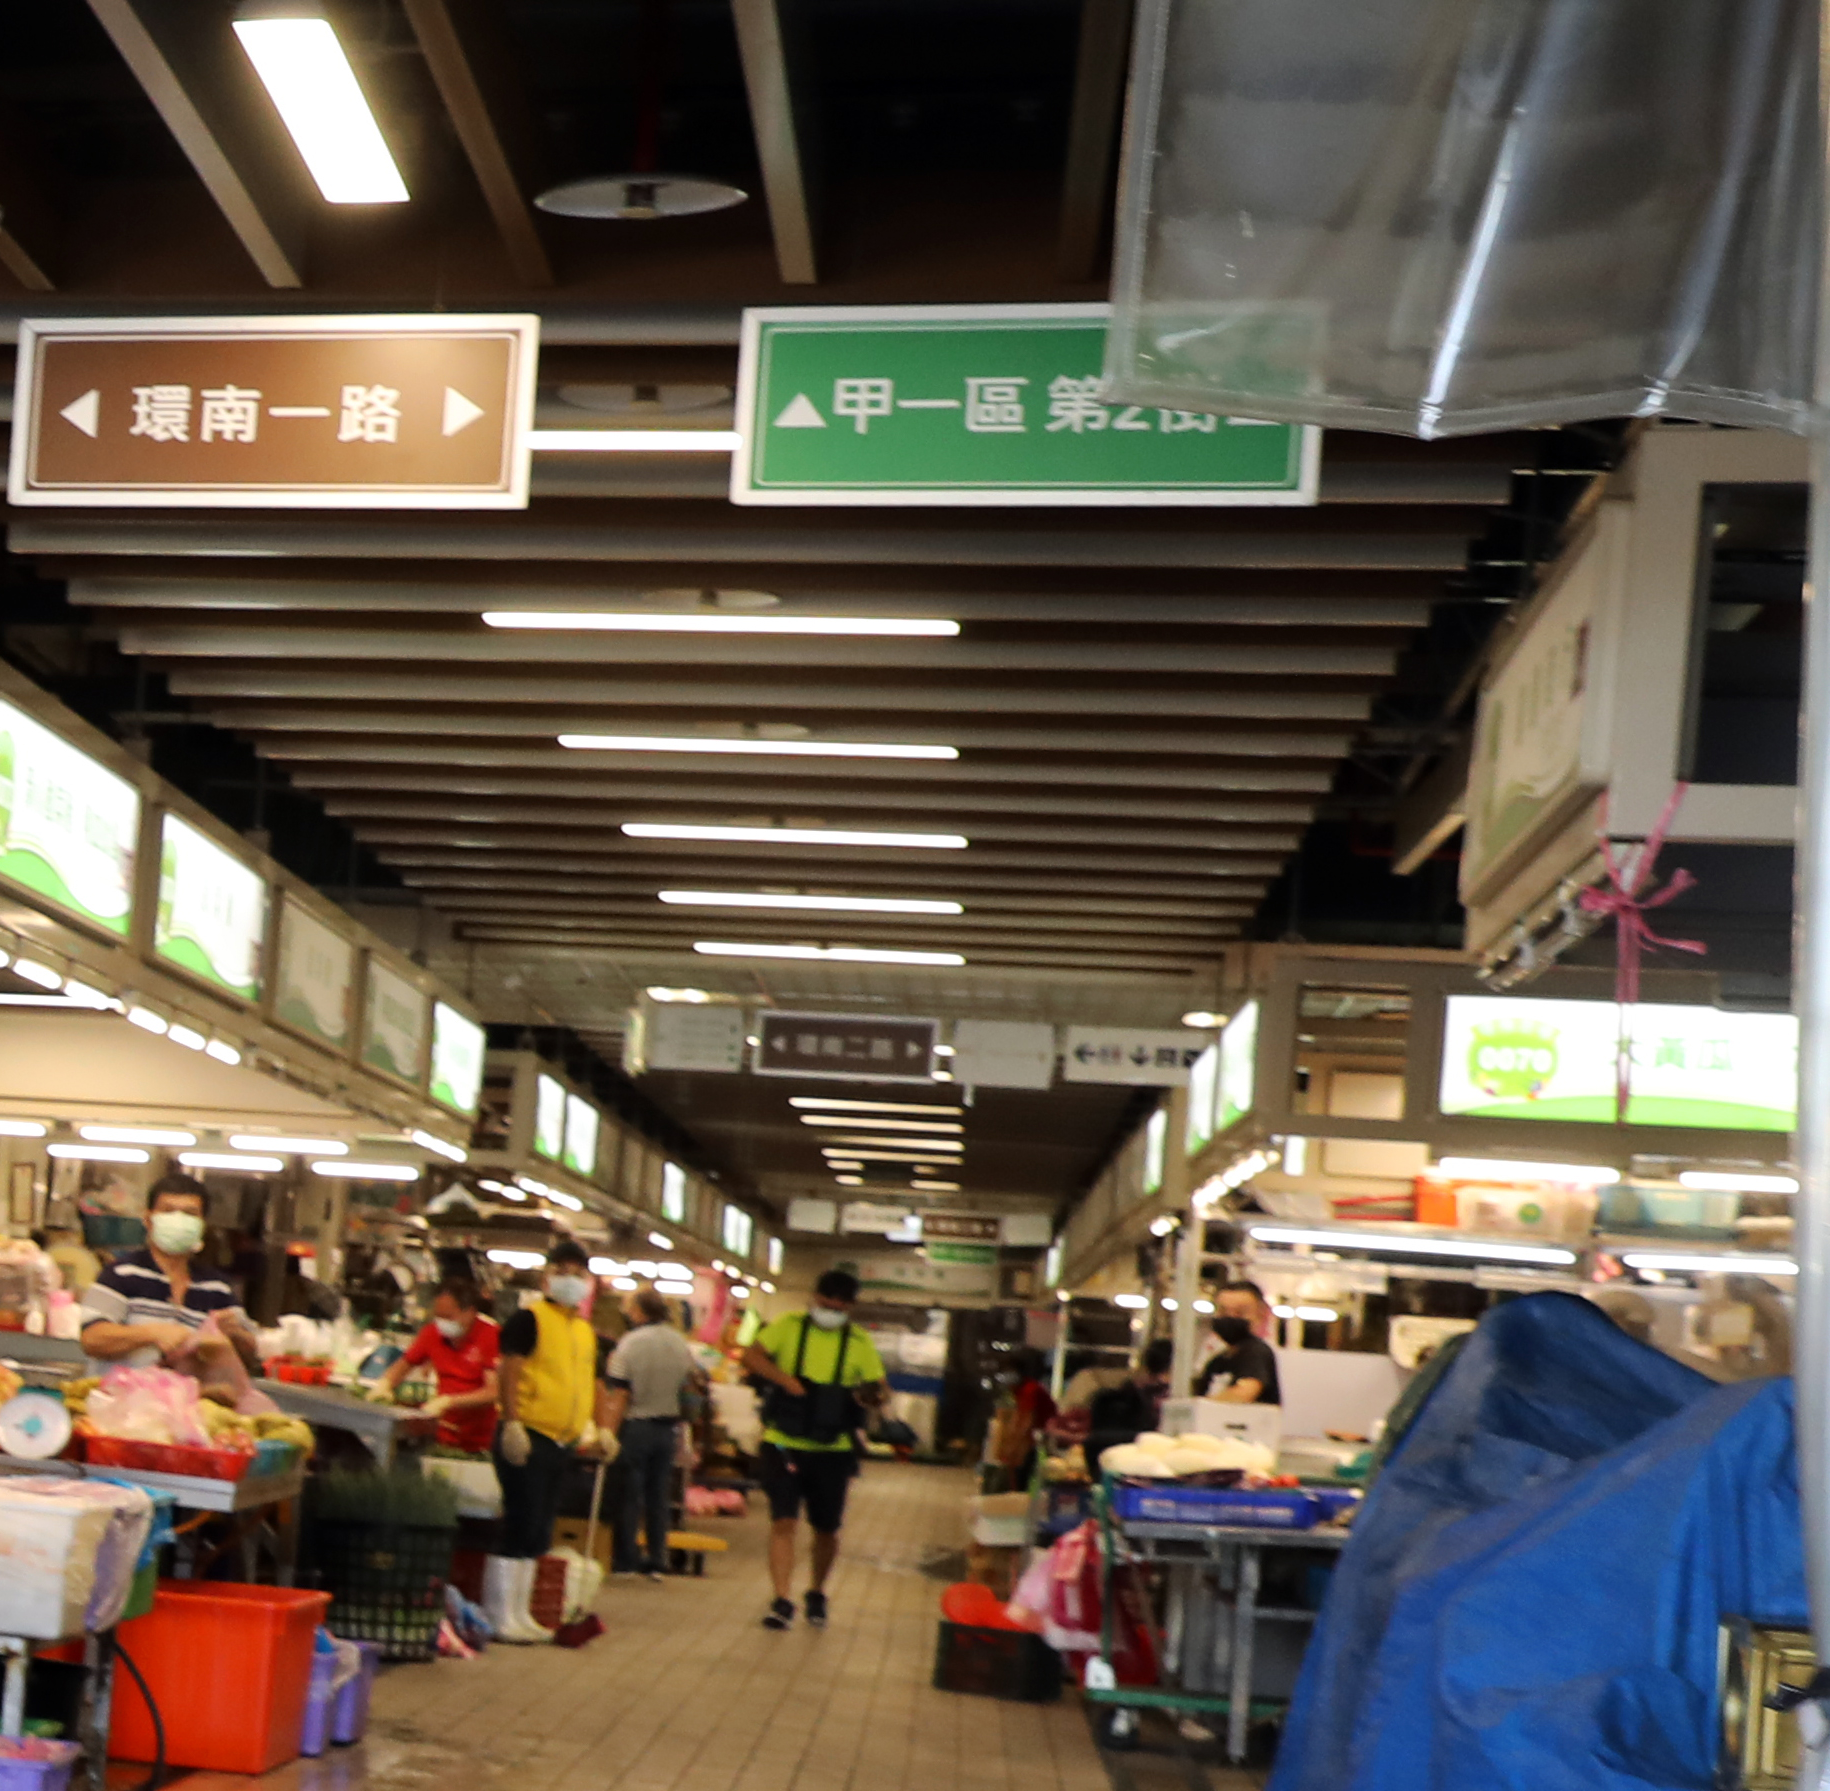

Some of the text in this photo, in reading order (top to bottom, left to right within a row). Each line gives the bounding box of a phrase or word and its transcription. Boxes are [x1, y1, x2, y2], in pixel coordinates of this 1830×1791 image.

[128, 384, 403, 444] 環南一路
[832, 377, 1028, 435] 甲一區
